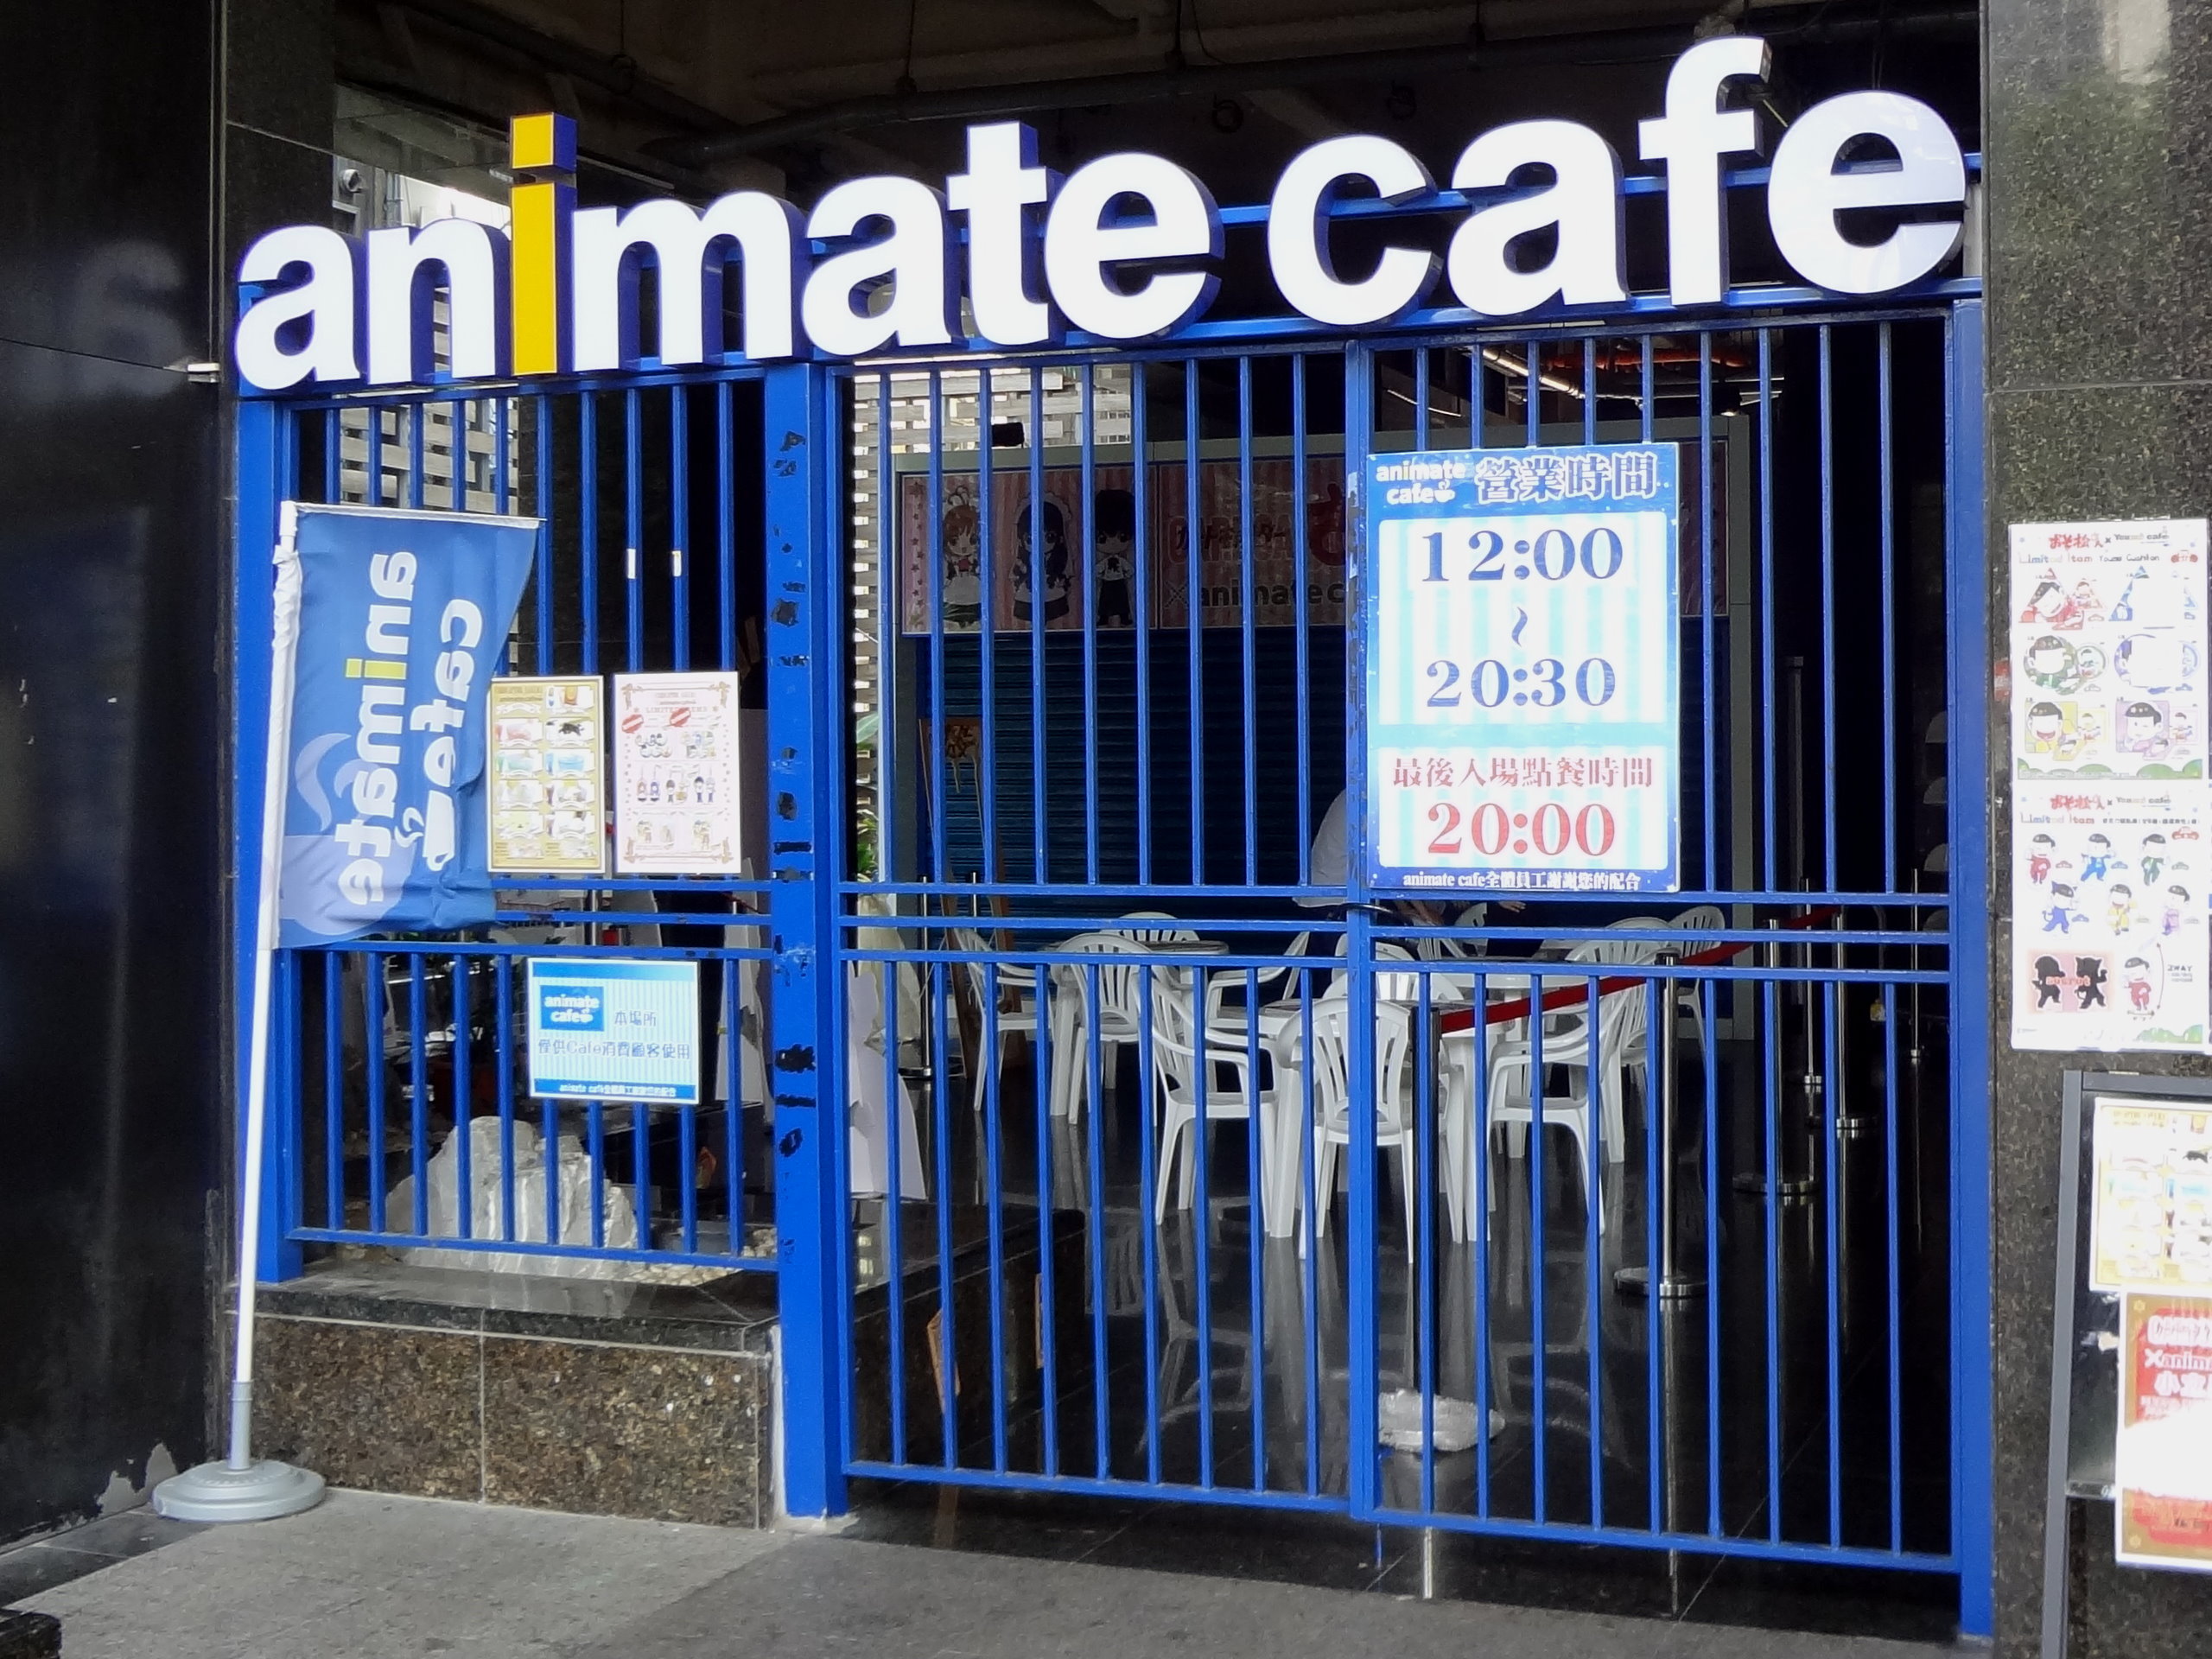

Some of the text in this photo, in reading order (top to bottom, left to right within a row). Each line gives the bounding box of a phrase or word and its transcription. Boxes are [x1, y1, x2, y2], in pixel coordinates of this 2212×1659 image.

[234, 35, 1966, 389] animate cafe
[1376, 460, 1466, 482] animate
[1475, 452, 1657, 505] 營業時間
[1386, 484, 1434, 505] cafe
[1421, 527, 1624, 582] 12:00
[1426, 658, 1616, 708] 20:30
[1393, 757, 1652, 788] 最後入場點餐時間
[1427, 803, 1615, 855] 20:00
[1403, 871, 1455, 887] animate
[544, 994, 600, 1008] animate
[550, 1009, 582, 1023] cafe
[614, 1011, 657, 1027] 本場所
